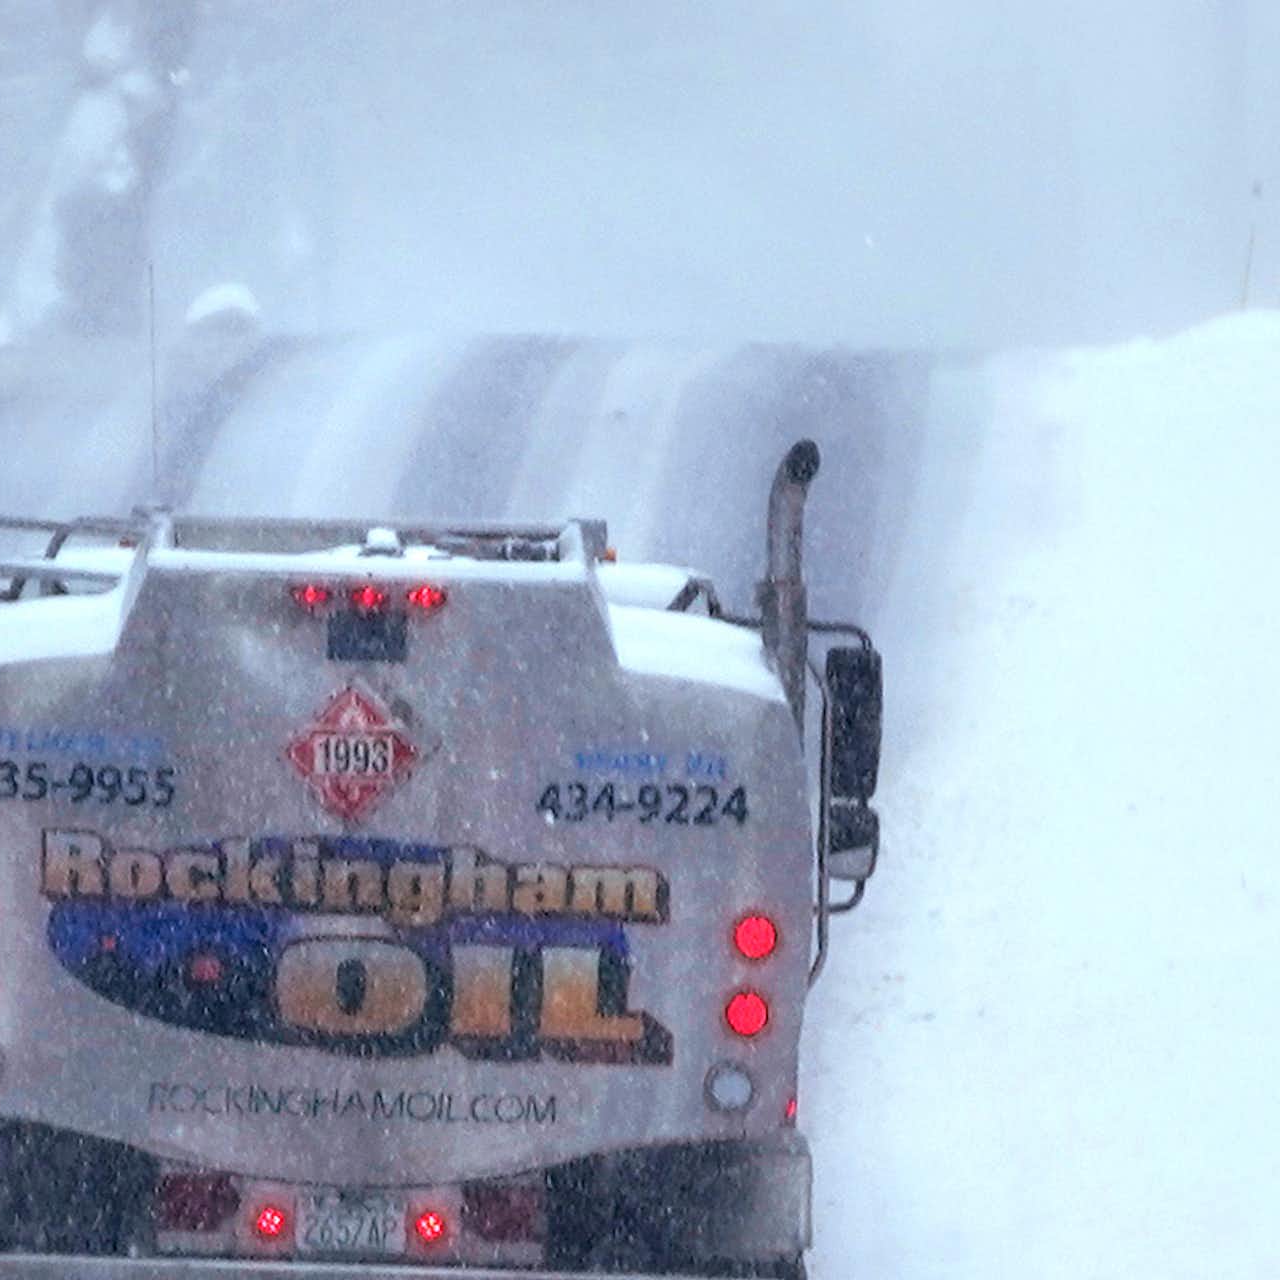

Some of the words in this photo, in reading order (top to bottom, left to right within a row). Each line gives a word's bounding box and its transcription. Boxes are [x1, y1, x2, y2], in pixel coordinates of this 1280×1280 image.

[319, 737, 389, 773] 1993
[535, 781, 749, 826] 434-9224
[40, 828, 670, 926] Rockingham
[274, 934, 674, 1067] OIL
[148, 1081, 558, 1124] ROCKINGHAMOIL.COM
